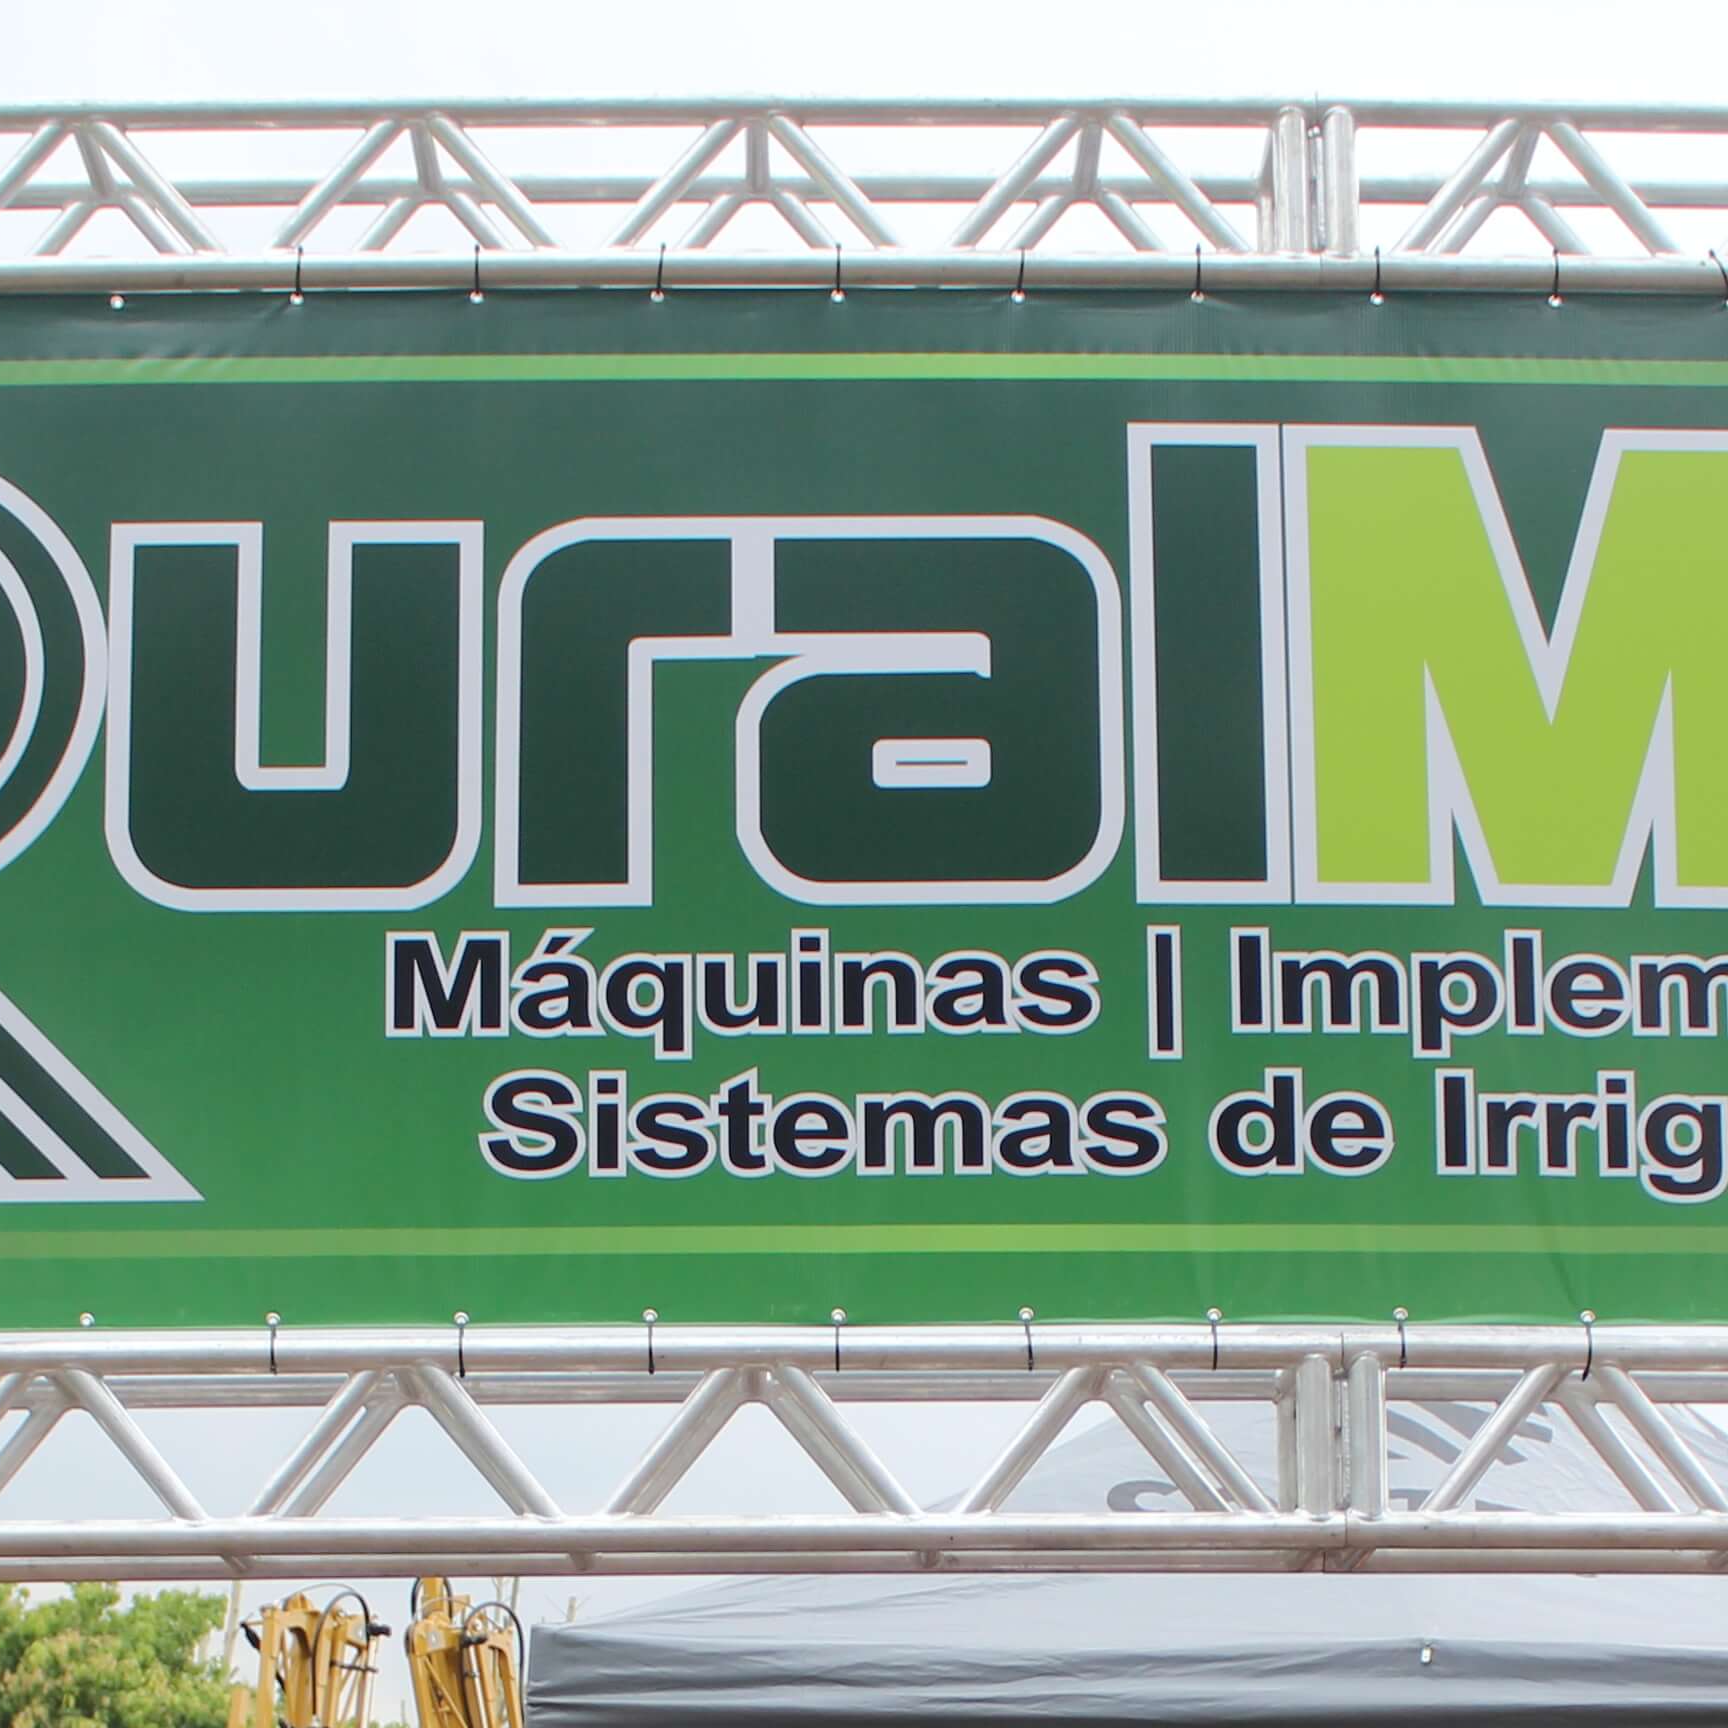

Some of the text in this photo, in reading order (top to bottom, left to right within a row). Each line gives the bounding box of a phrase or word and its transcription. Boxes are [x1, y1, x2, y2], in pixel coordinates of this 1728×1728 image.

[384, 926, 1101, 1060] Máquinas
[478, 1067, 1168, 1179] Sistemas
[1208, 1066, 1394, 1178] de
